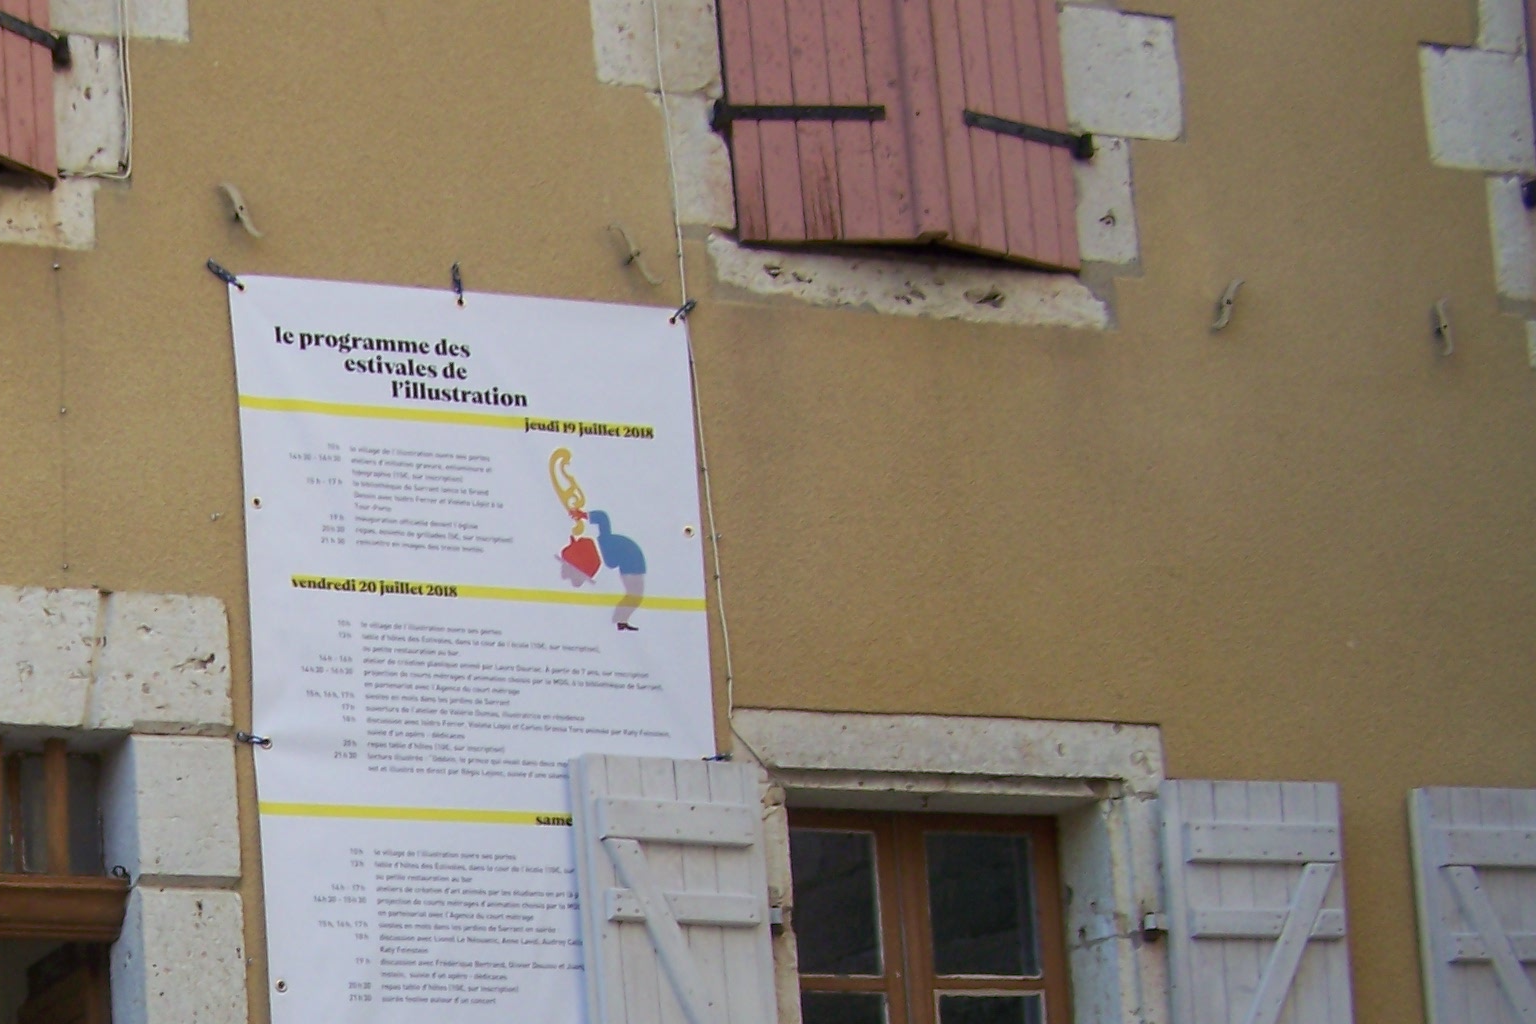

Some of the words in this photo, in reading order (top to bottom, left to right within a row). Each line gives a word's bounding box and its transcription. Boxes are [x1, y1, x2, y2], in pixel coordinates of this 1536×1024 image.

[274, 326, 294, 344] le
[299, 331, 430, 355] programme
[434, 338, 471, 358] des
[344, 355, 438, 378] estivales
[442, 362, 468, 380] de
[392, 380, 527, 407] l'illustration
[524, 417, 559, 433] jeudi
[562, 422, 576, 433] 19
[579, 422, 620, 437] juillet
[623, 426, 654, 439] 2018
[292, 577, 356, 592] vendredi
[358, 581, 376, 593] 20
[380, 580, 423, 596] juillet
[426, 584, 457, 597] 2018
